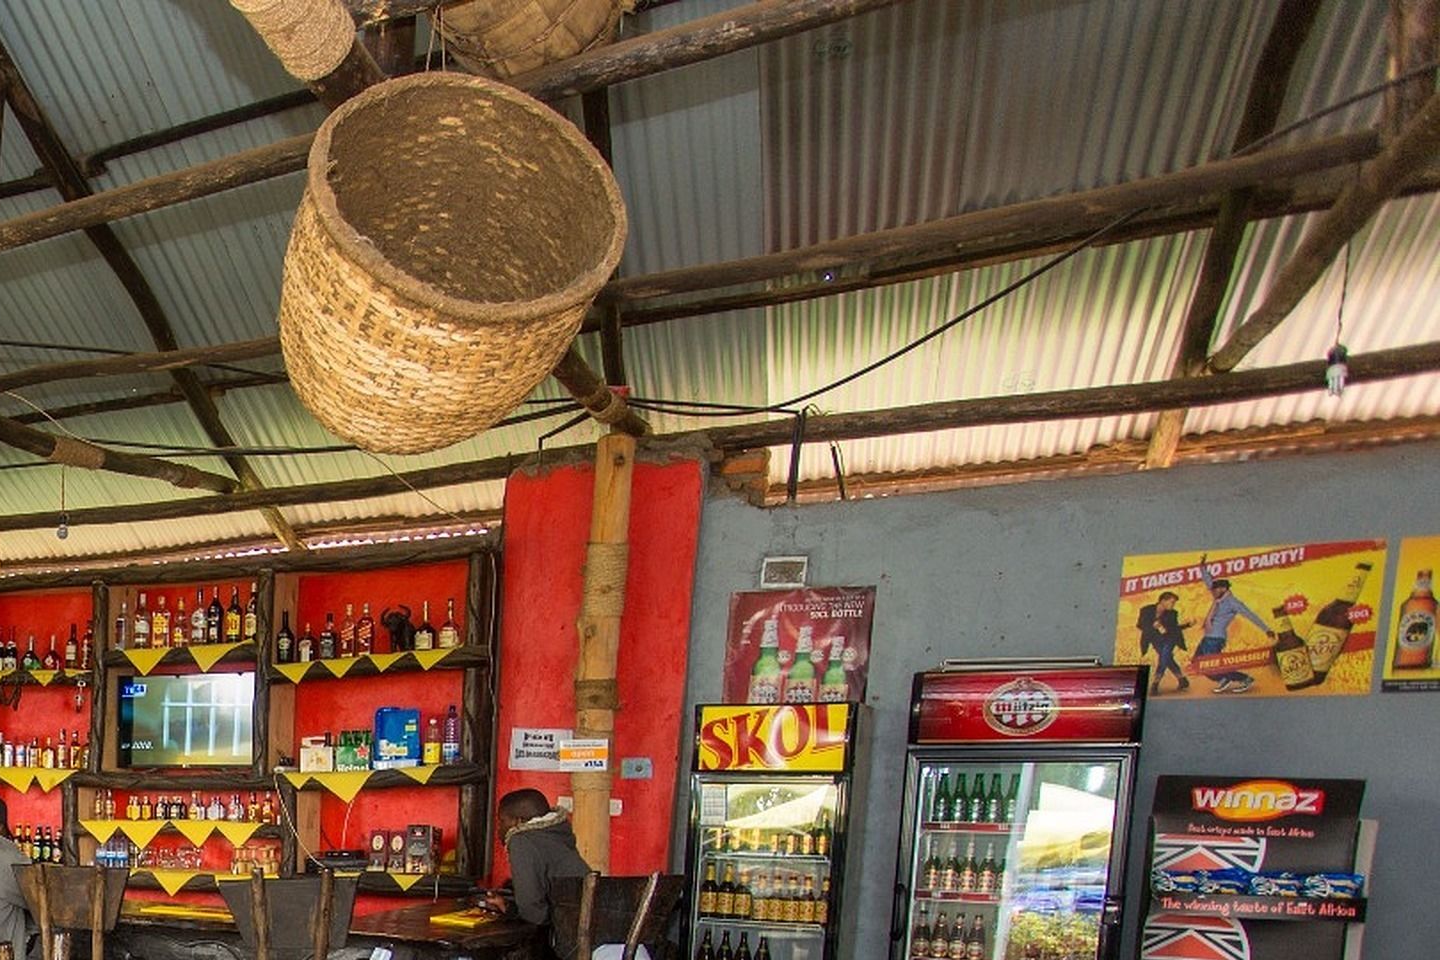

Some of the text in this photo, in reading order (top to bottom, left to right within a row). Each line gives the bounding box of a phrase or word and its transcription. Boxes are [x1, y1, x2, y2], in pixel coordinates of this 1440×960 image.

[1125, 578, 1137, 592] IT
[1140, 570, 1184, 590] TAKES
[1226, 559, 1246, 574] TO
[1249, 547, 1306, 570] PARTY!
[701, 704, 846, 770] SKOL
[1161, 897, 1182, 910] The
[1183, 900, 1230, 917] winning
[1232, 901, 1268, 914] taste
[1271, 901, 1284, 914] of
[1319, 903, 1356, 917] Africa
